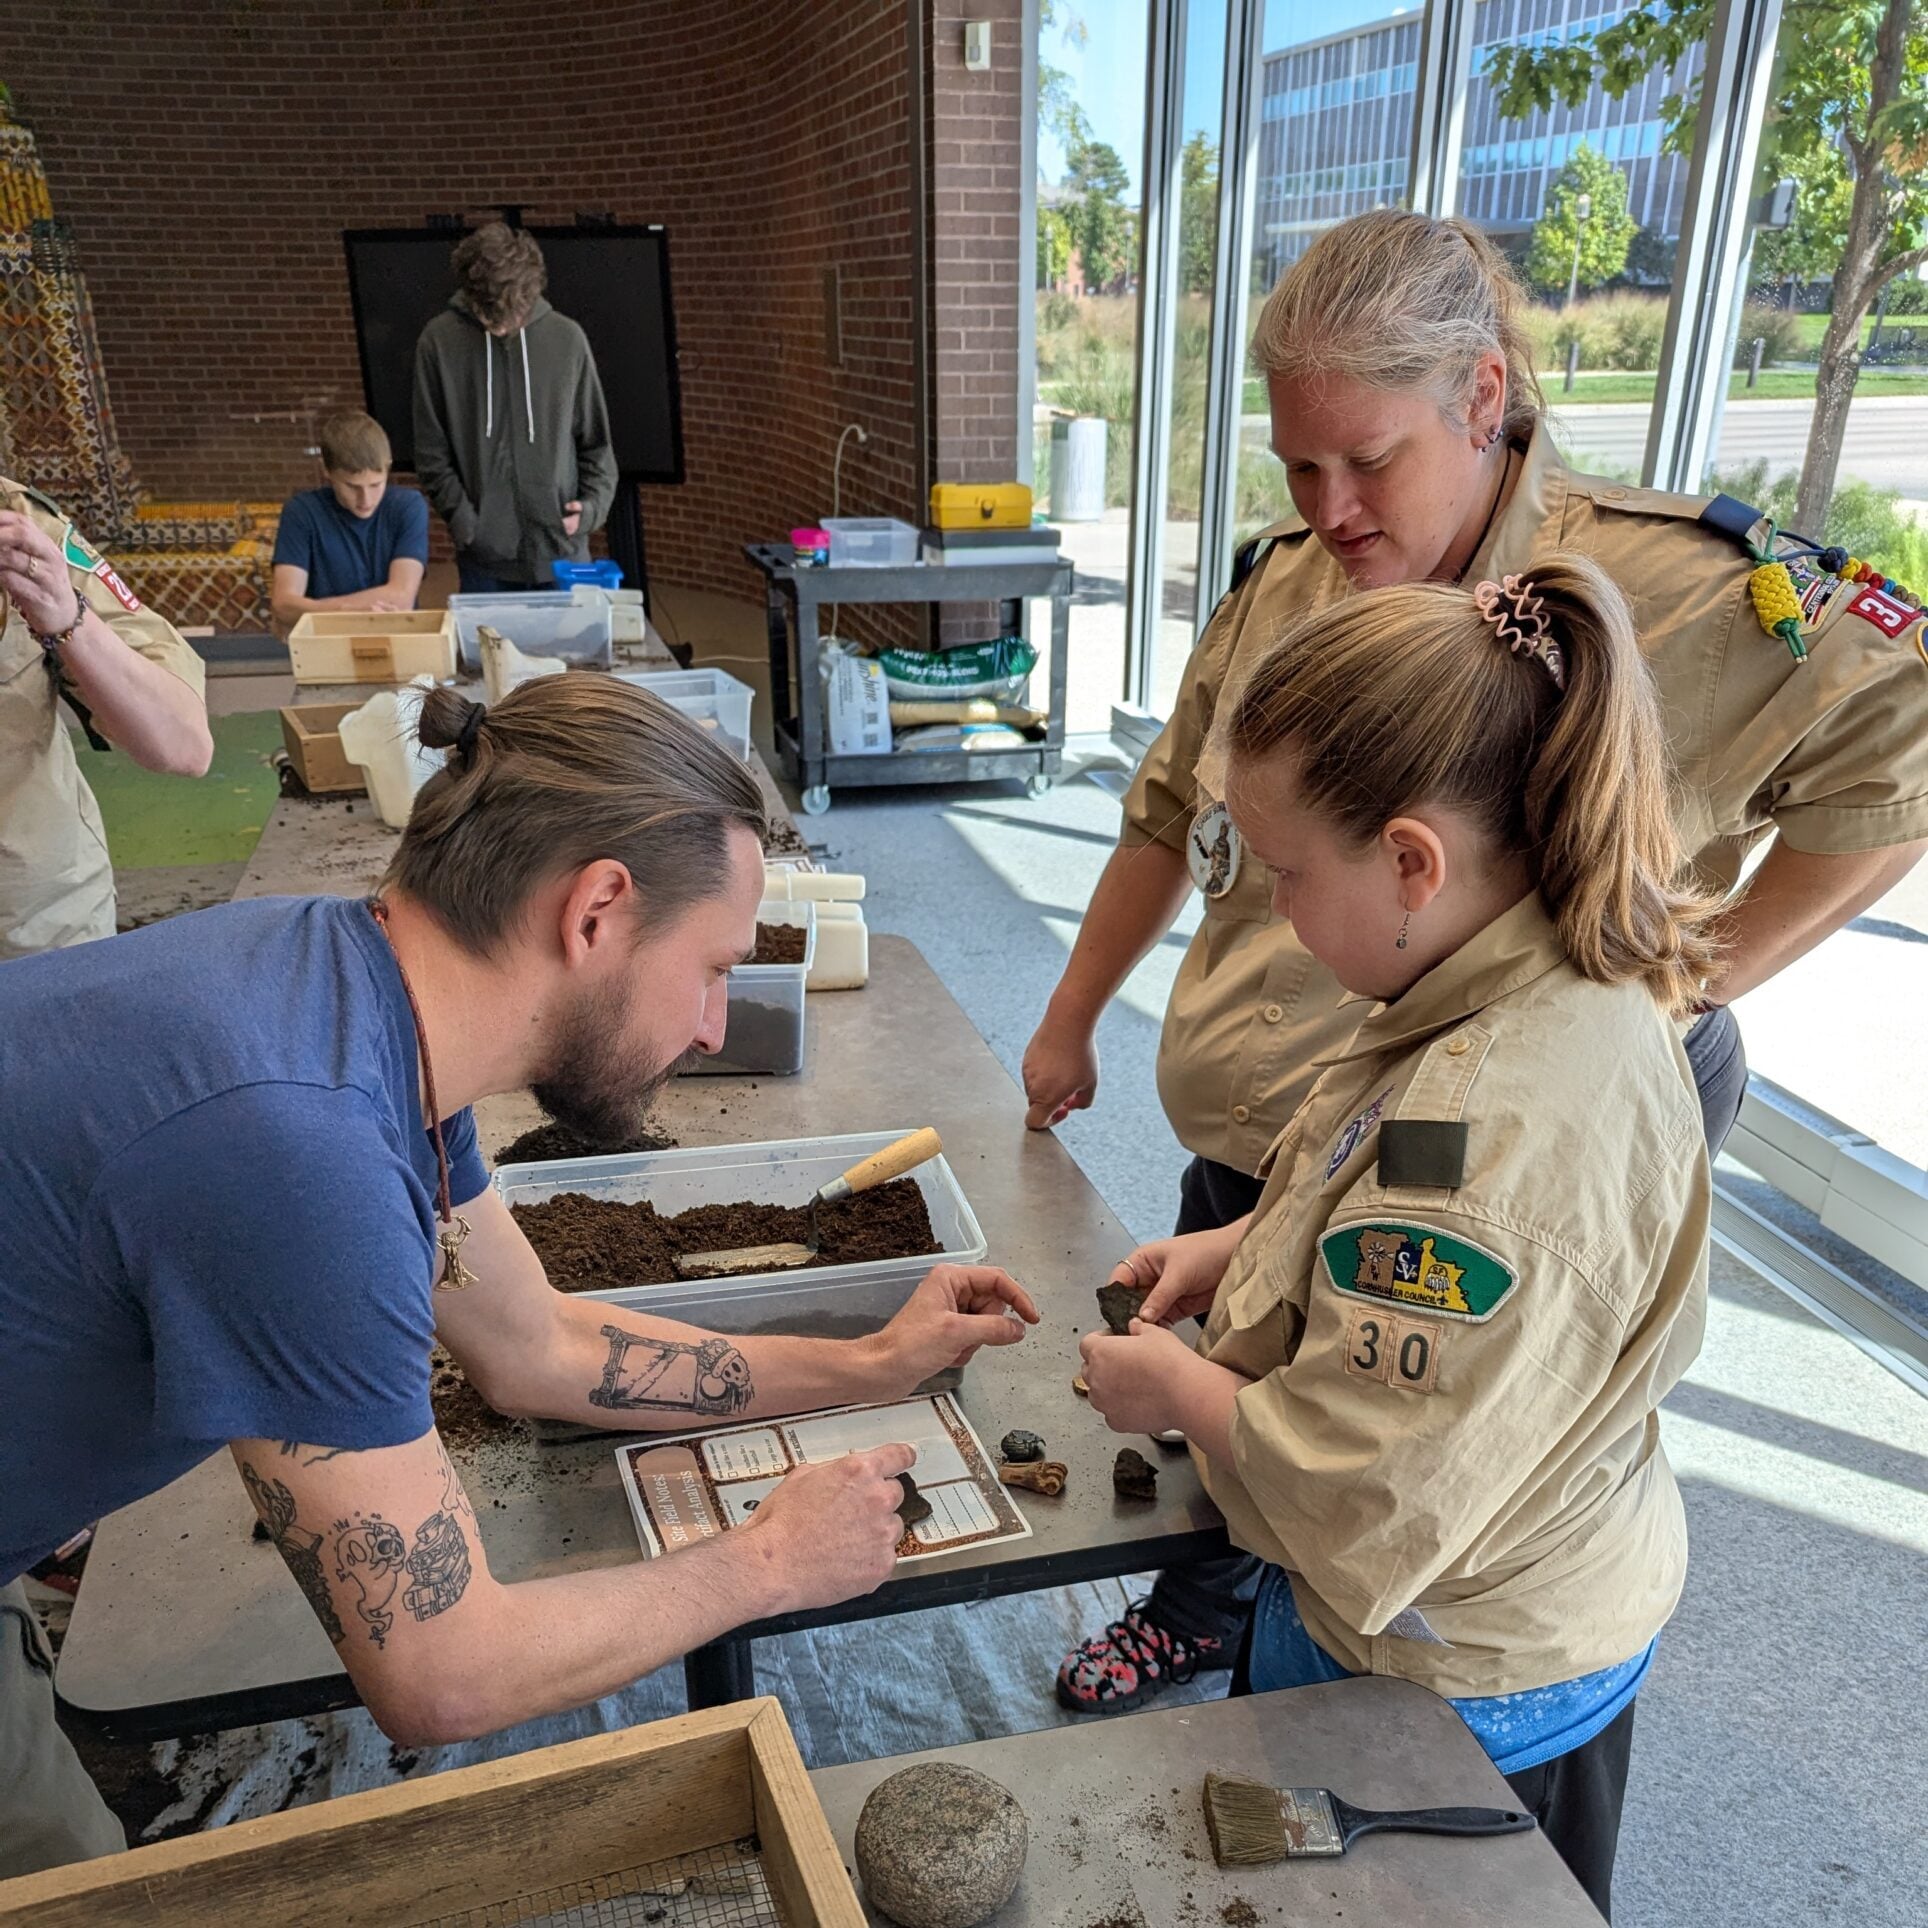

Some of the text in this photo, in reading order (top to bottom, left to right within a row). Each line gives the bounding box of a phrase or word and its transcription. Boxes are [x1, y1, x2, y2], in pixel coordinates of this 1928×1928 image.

[1404, 1290, 1437, 1305] COUNCIL
[1353, 1320, 1429, 1381] 30
[680, 1470, 715, 1537] rtifact Analysis
[659, 1504, 681, 1525] Field
[670, 1525, 688, 1545] Site
